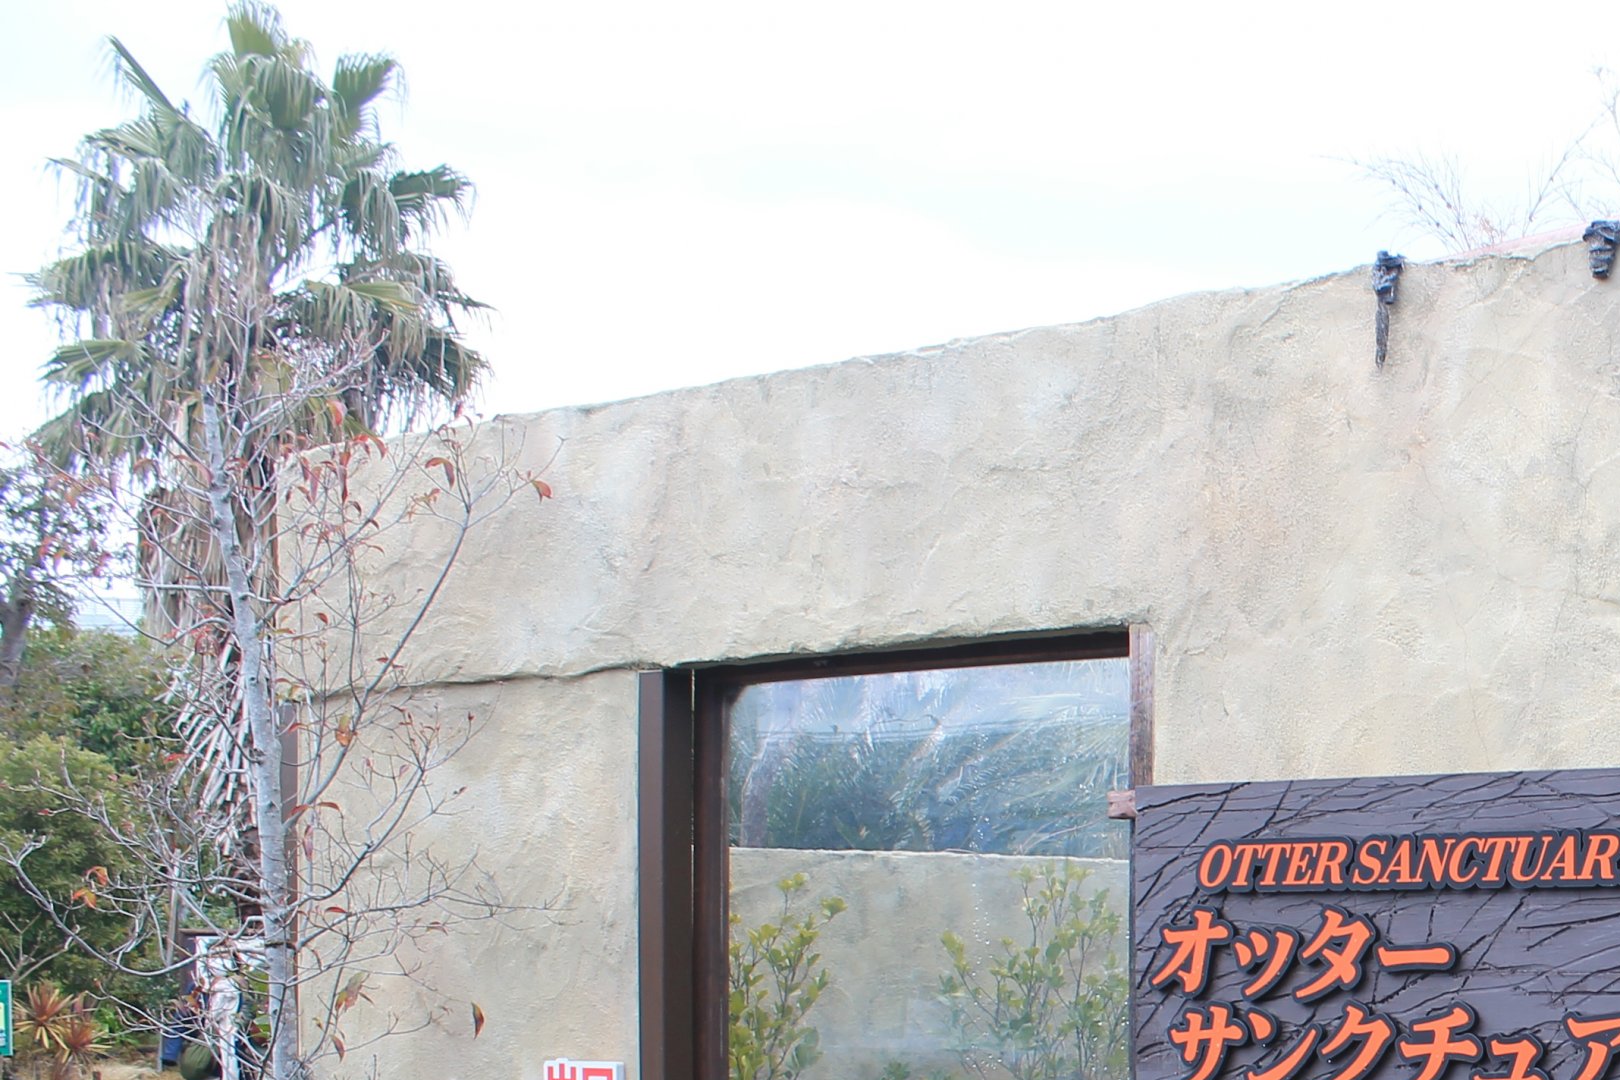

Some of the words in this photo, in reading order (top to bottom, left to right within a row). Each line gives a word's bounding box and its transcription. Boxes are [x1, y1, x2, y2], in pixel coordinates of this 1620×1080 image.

[1199, 841, 1348, 887] OTTER
[1150, 909, 1452, 998] オッター
